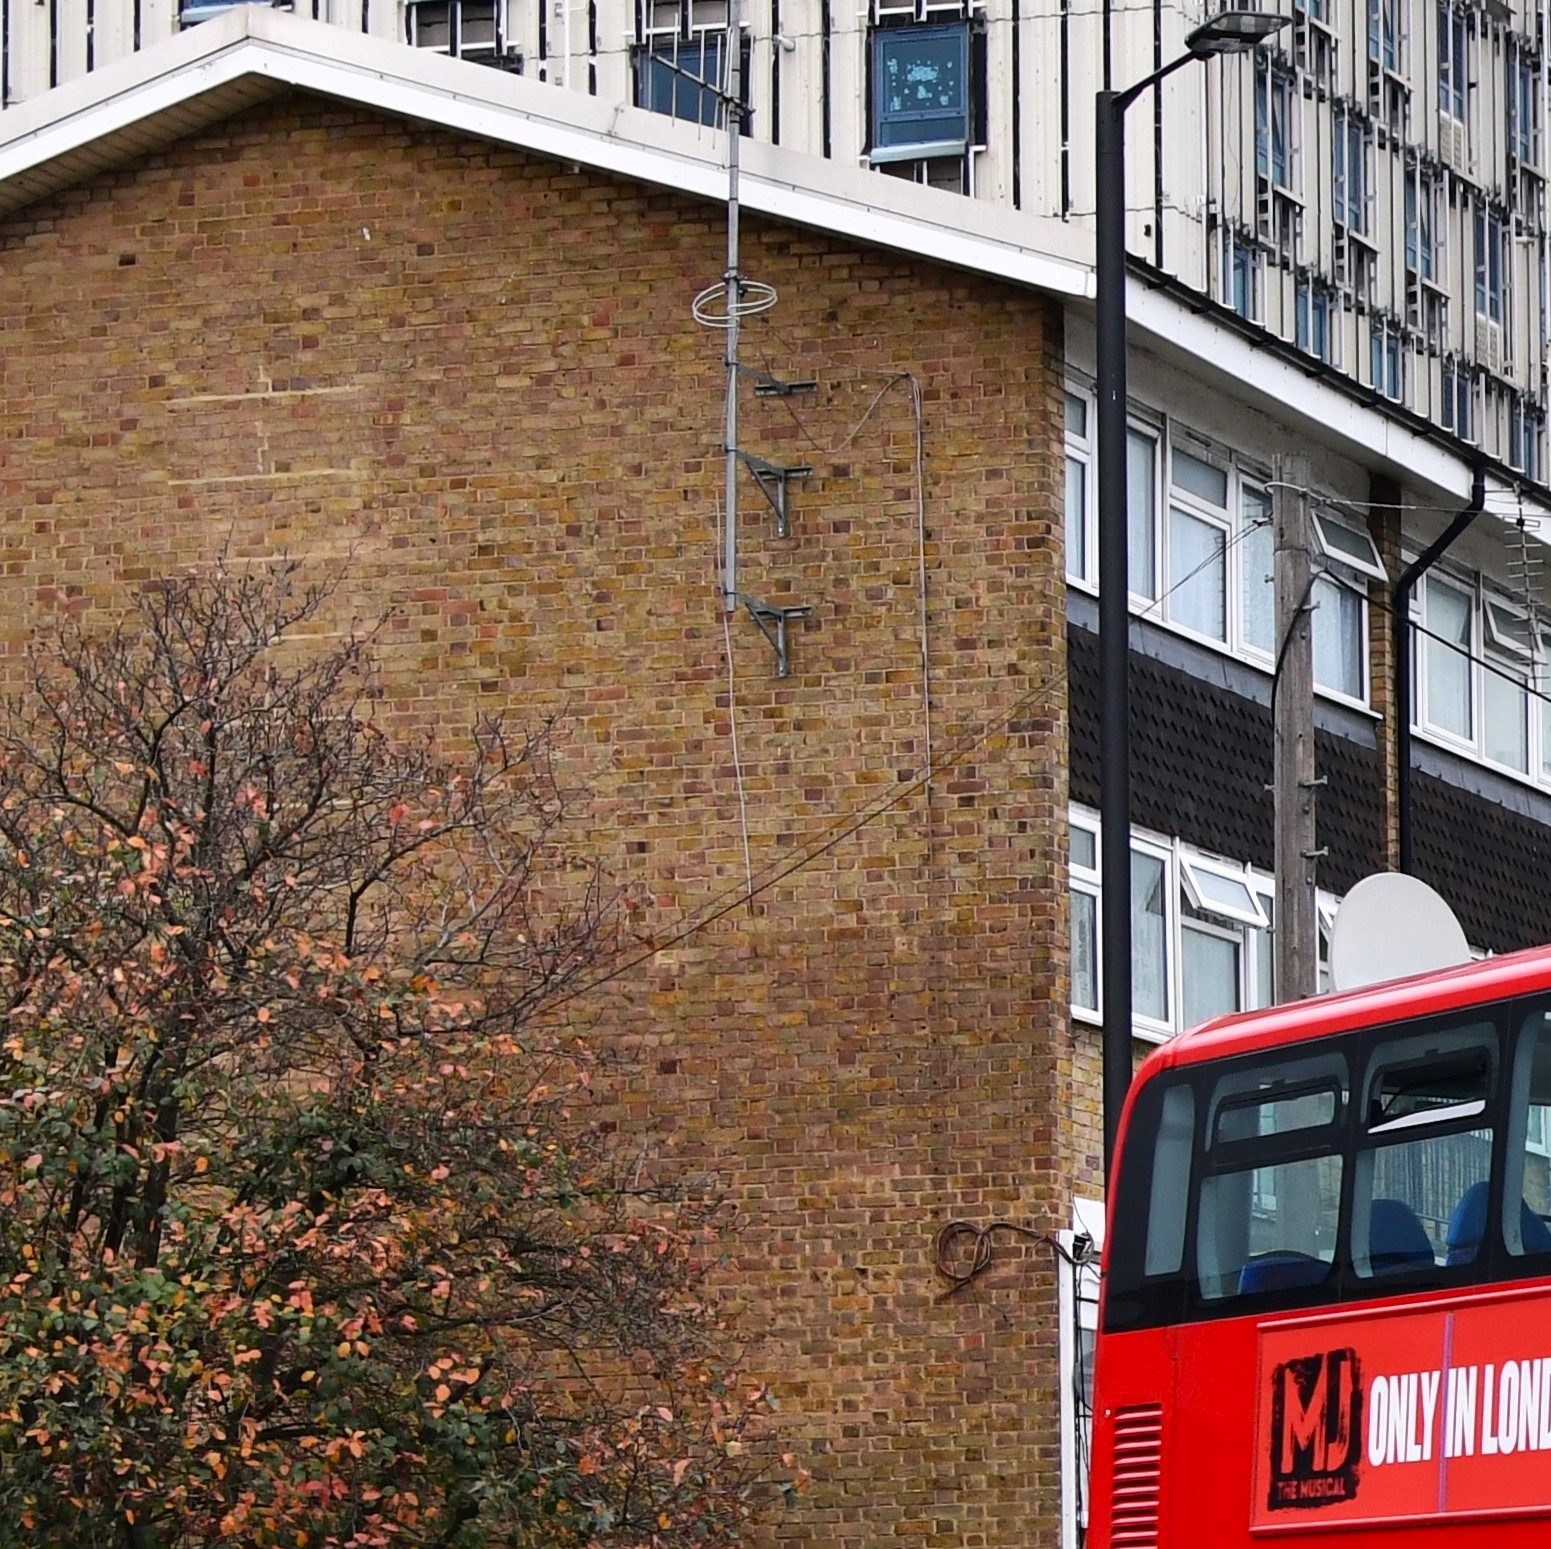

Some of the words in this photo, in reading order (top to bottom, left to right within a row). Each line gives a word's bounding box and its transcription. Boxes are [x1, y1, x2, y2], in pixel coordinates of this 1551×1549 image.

[1280, 1353, 1353, 1474] MJ
[1367, 1370, 1441, 1467] ONLY
[1443, 1365, 1478, 1458] IN
[1278, 1481, 1298, 1500] THE
[1301, 1476, 1345, 1498] MUSICAL
